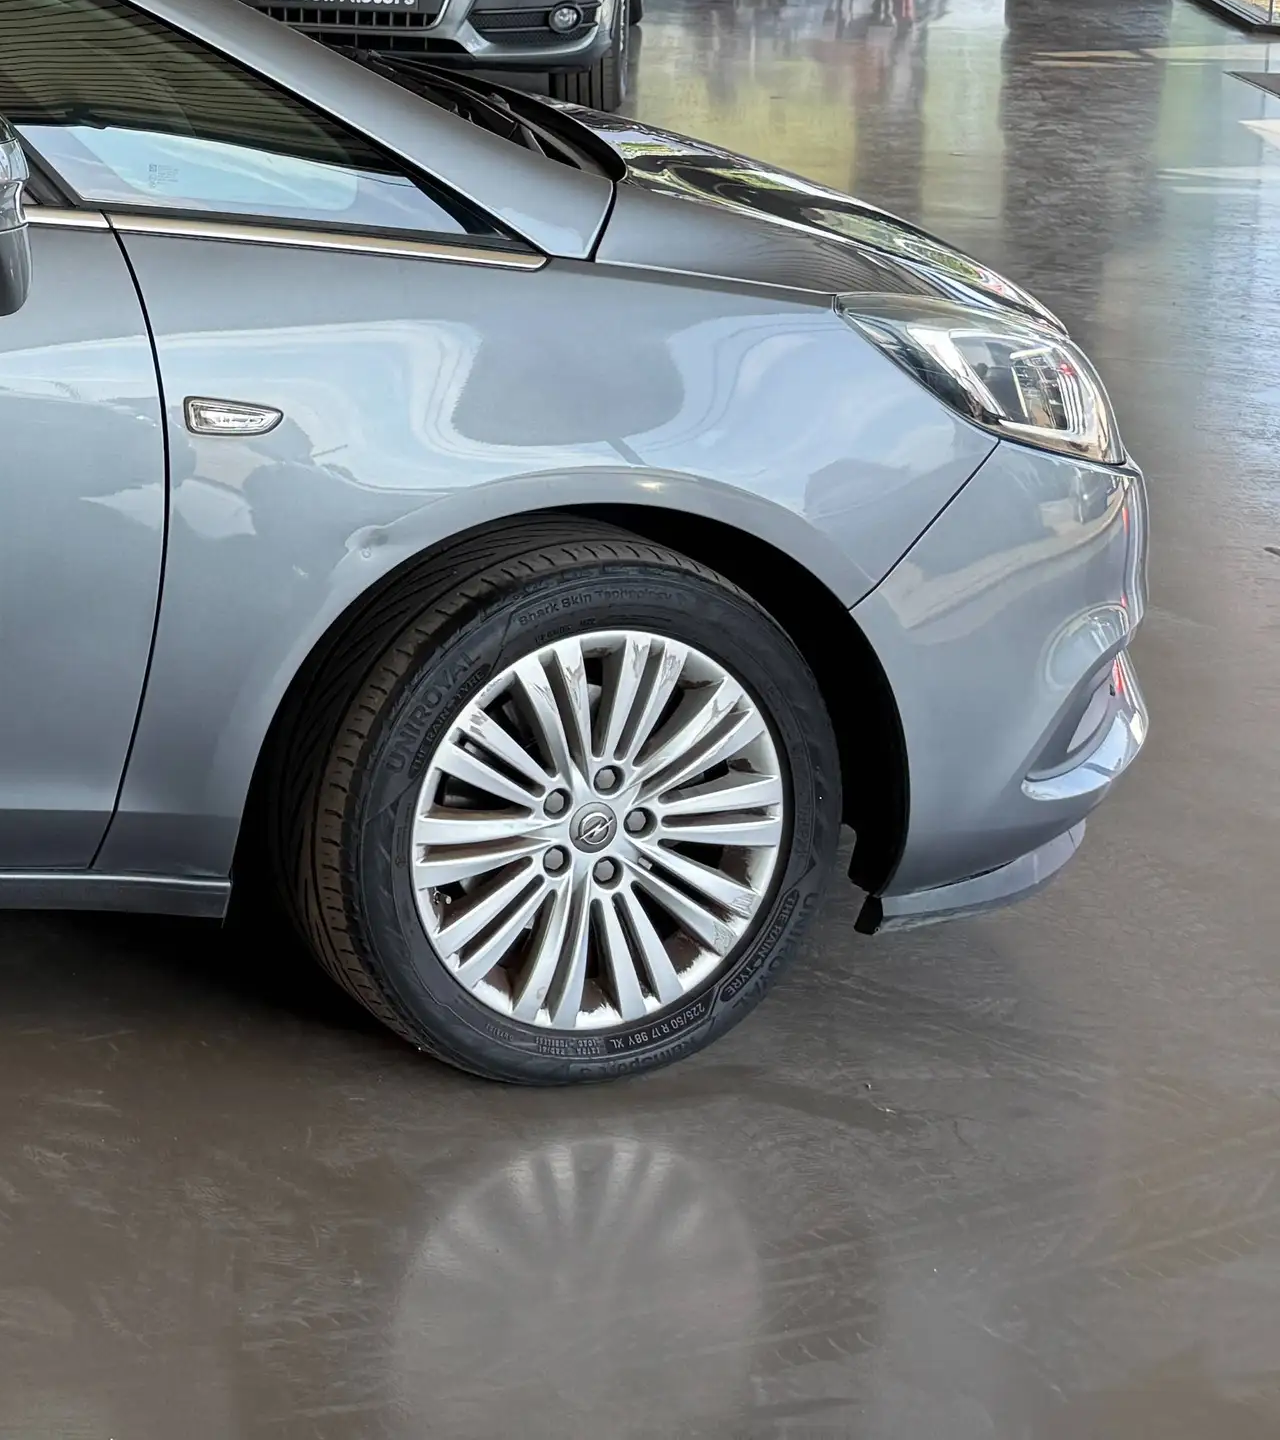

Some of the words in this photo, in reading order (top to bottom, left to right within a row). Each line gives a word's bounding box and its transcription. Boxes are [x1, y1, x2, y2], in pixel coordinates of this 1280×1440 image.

[561, 592, 593, 610] Skin
[385, 650, 482, 774] UNIROYAL
[413, 746, 427, 770] THE
[426, 707, 450, 743] RAIN
[453, 670, 486, 703] TYRE
[778, 897, 796, 924] THE
[756, 925, 782, 960] RAIN
[725, 965, 755, 996] TYRE
[660, 1023, 669, 1034] R
[670, 1003, 706, 1029] 225/50
[609, 1038, 624, 1050] XL
[627, 1031, 649, 1046] 98Y
[651, 1027, 661, 1039] 17
